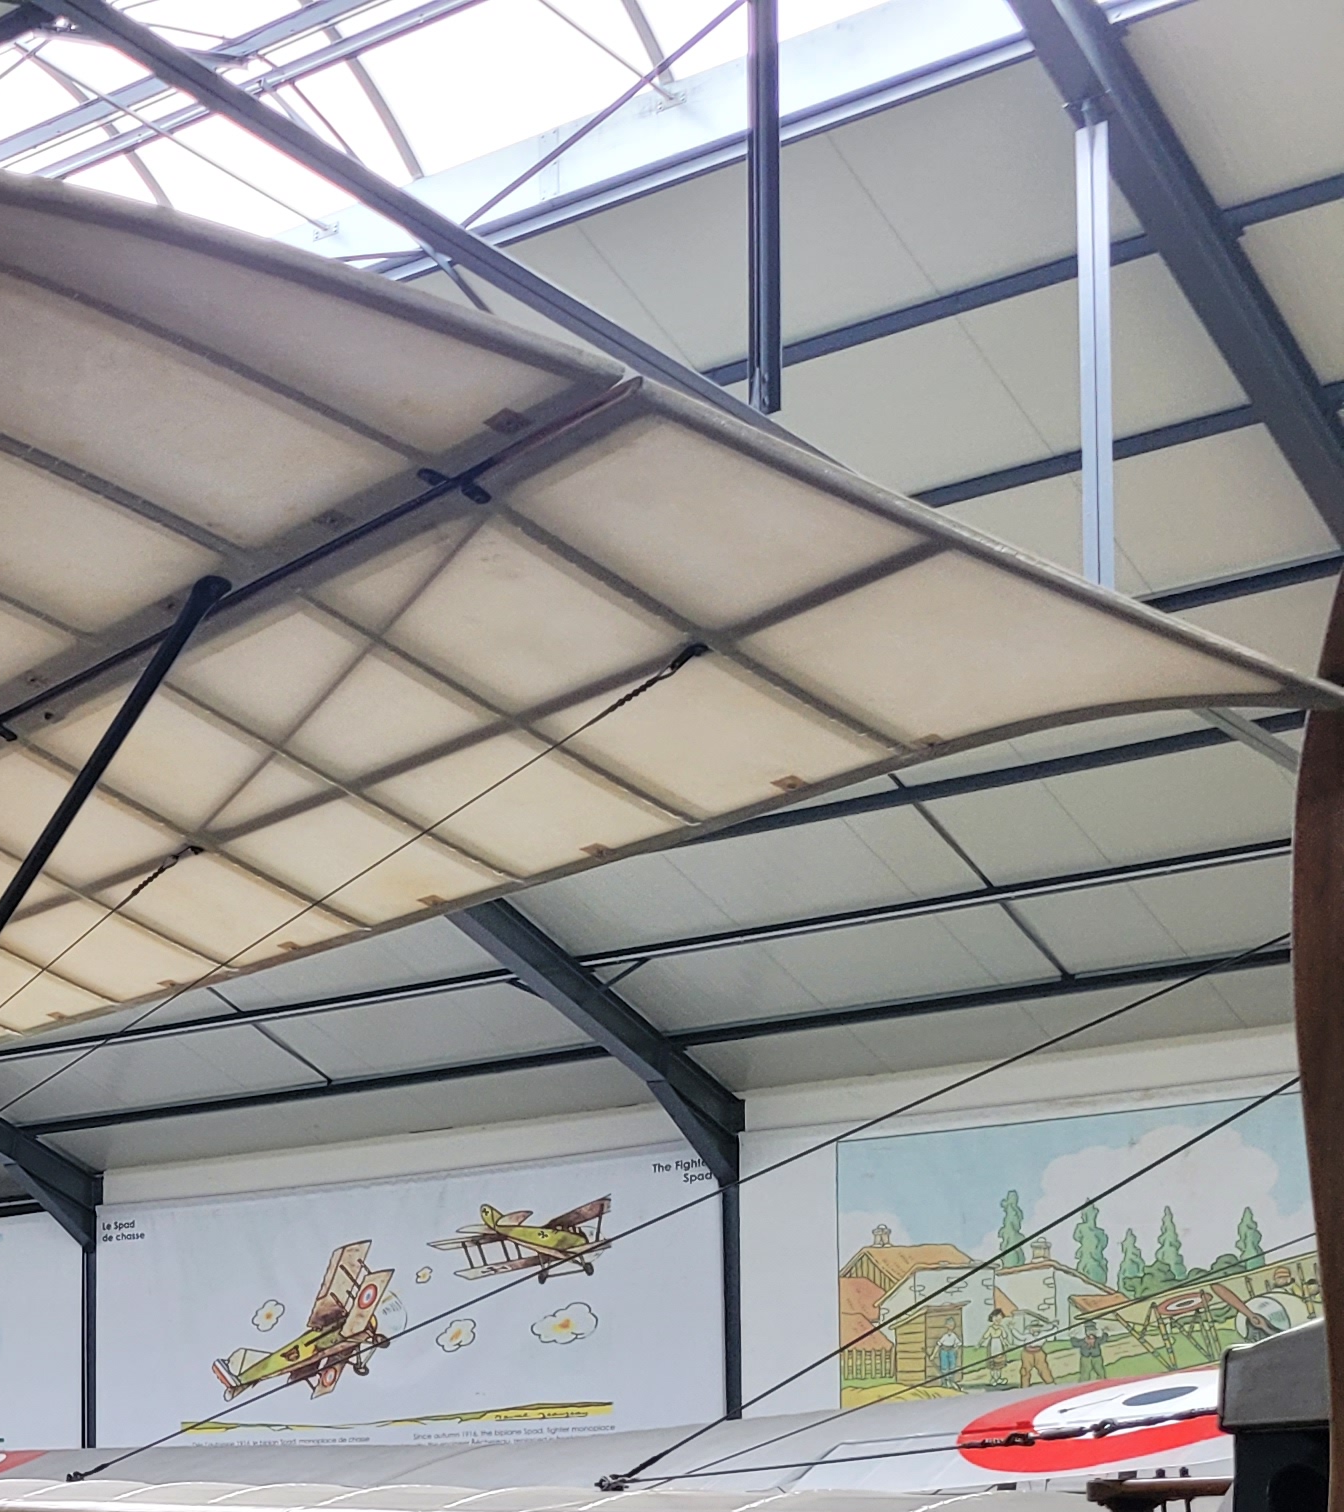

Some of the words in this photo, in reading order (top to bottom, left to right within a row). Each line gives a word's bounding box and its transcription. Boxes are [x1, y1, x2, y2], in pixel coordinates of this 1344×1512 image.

[652, 1163, 671, 1173] The
[675, 1159, 707, 1171] Fighte
[683, 1171, 712, 1184] Spad
[102, 1222, 111, 1231] Le
[114, 1220, 135, 1231] Spad
[102, 1234, 113, 1242] de
[116, 1232, 145, 1241] chasse
[494, 1428, 522, 1437] biplane
